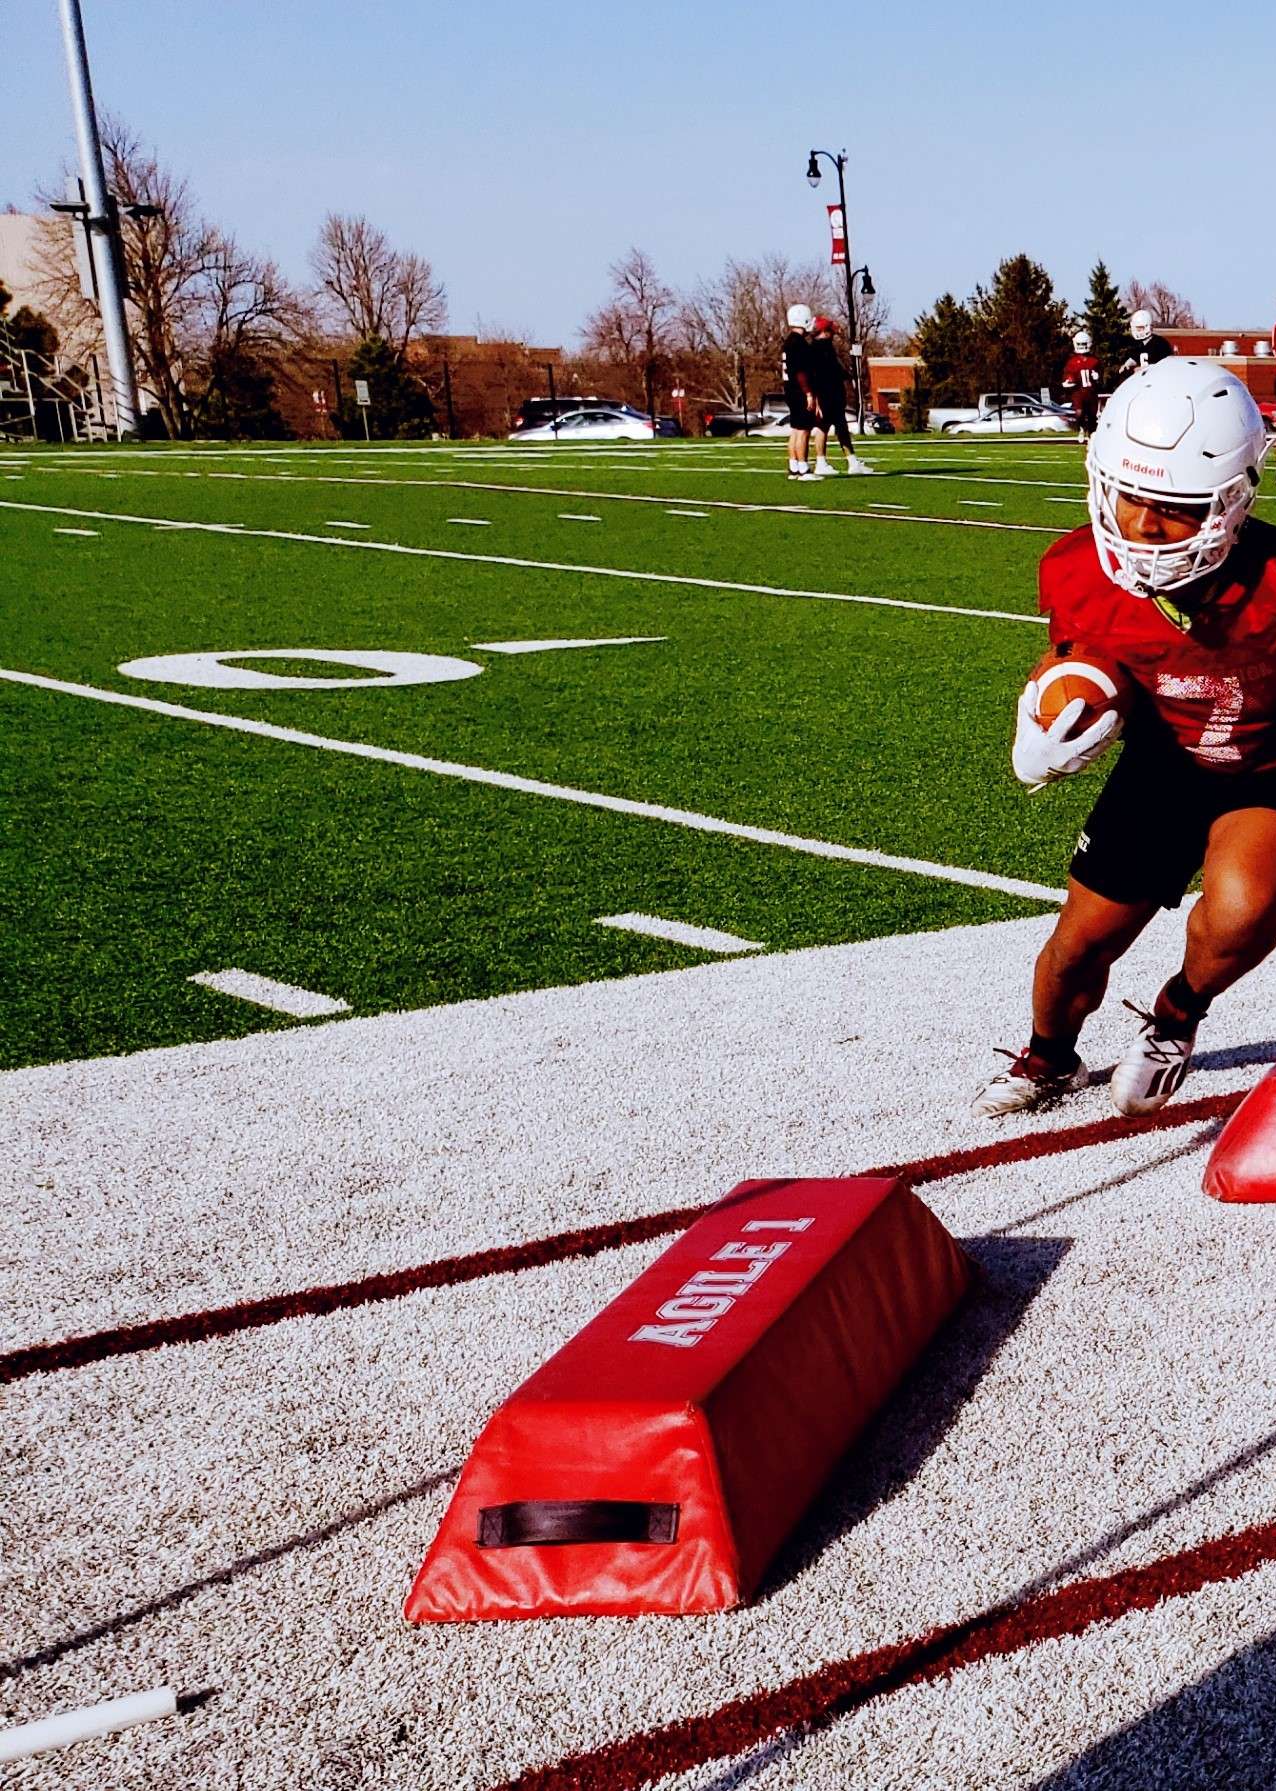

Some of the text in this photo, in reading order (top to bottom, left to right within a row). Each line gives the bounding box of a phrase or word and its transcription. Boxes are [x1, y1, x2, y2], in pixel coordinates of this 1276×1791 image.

[1121, 458, 1165, 478] Riddell
[1156, 672, 1244, 762] 7
[627, 1217, 816, 1348] AGILE 1
